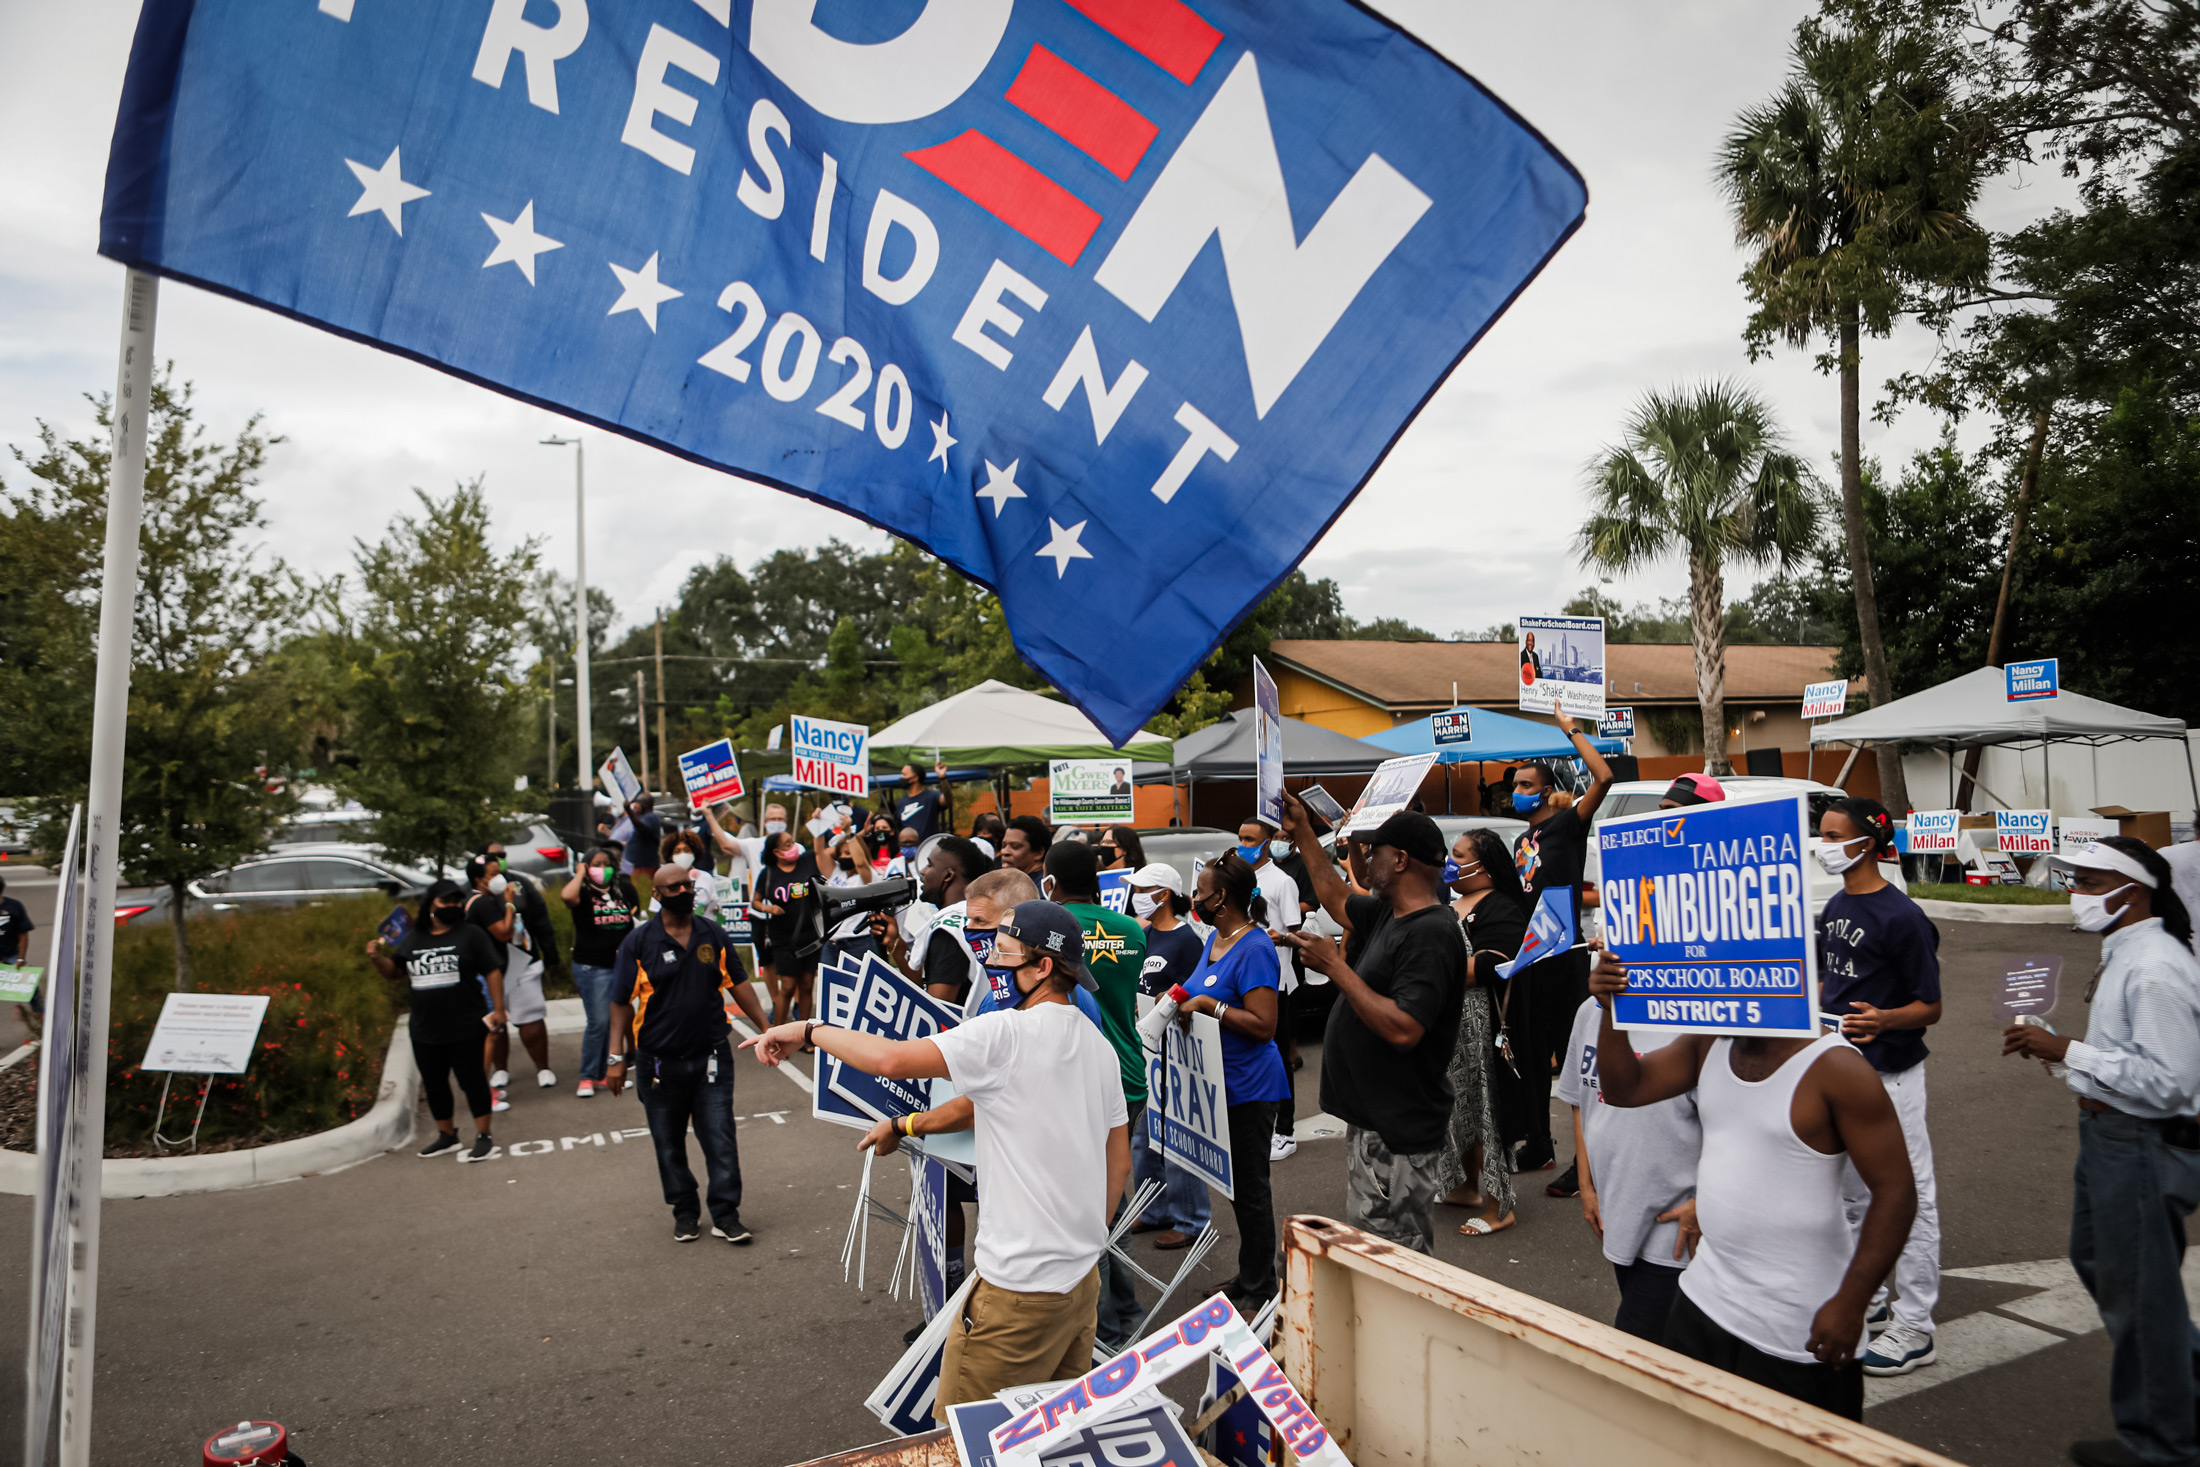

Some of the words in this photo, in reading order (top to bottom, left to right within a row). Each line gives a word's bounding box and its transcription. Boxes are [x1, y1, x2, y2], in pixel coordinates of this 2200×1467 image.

[318, 0, 1238, 504] RESIDENT
[697, 279, 913, 450] 2020
[1521, 619, 1600, 630] ShakeForSchoolBoard.com
[2012, 665, 2044, 677] Nancy
[1521, 685, 1538, 696] Henry
[1540, 683, 1565, 698] "Shake"
[1567, 690, 1603, 704] Washington
[1805, 684, 1845, 699] Nancy
[2012, 679, 2051, 692] Millan
[1600, 711, 1631, 721] IDEN
[1803, 701, 1842, 717] Millan
[1434, 714, 1467, 727] BIDEN
[1435, 725, 1469, 736] HARRIS
[1600, 720, 1632, 731] HARRIS
[794, 719, 864, 763] Nancy
[796, 757, 863, 793] Millan
[1052, 762, 1069, 773] VOTE
[1054, 774, 1109, 790] MYERS
[1914, 814, 1956, 831] Nancy
[1998, 812, 2048, 832] Nancy
[1601, 827, 1661, 850] RE-ELECT
[1913, 833, 1955, 850] Millan
[2000, 835, 2050, 851] Millan
[1688, 833, 1797, 869] TAMARA
[722, 907, 750, 920] BIDE
[841, 899, 856, 909] PYLE
[722, 921, 752, 932] HARRI
[1826, 918, 1865, 948] POLO
[1685, 945, 1707, 958] FOR
[1626, 968, 1655, 988] CPS
[1656, 967, 1726, 988] SCHOOL
[1728, 966, 1800, 988] BOARD
[865, 974, 951, 1041] BID
[1647, 999, 1740, 1022] DISTRICT
[1746, 1001, 1761, 1023] 5
[1157, 1027, 1204, 1075] YNN
[874, 1075, 930, 1111] JOEBIDEN
[1151, 1058, 1216, 1139] GRAY
[457, 1110, 791, 1163] OMPT
[1170, 1126, 1197, 1158] SCHOOL
[1200, 1142, 1223, 1175] BOARD
[1235, 1345, 1267, 1373] I
[994, 1296, 1235, 1454] BIDEN
[1250, 1362, 1328, 1457] VOTED
